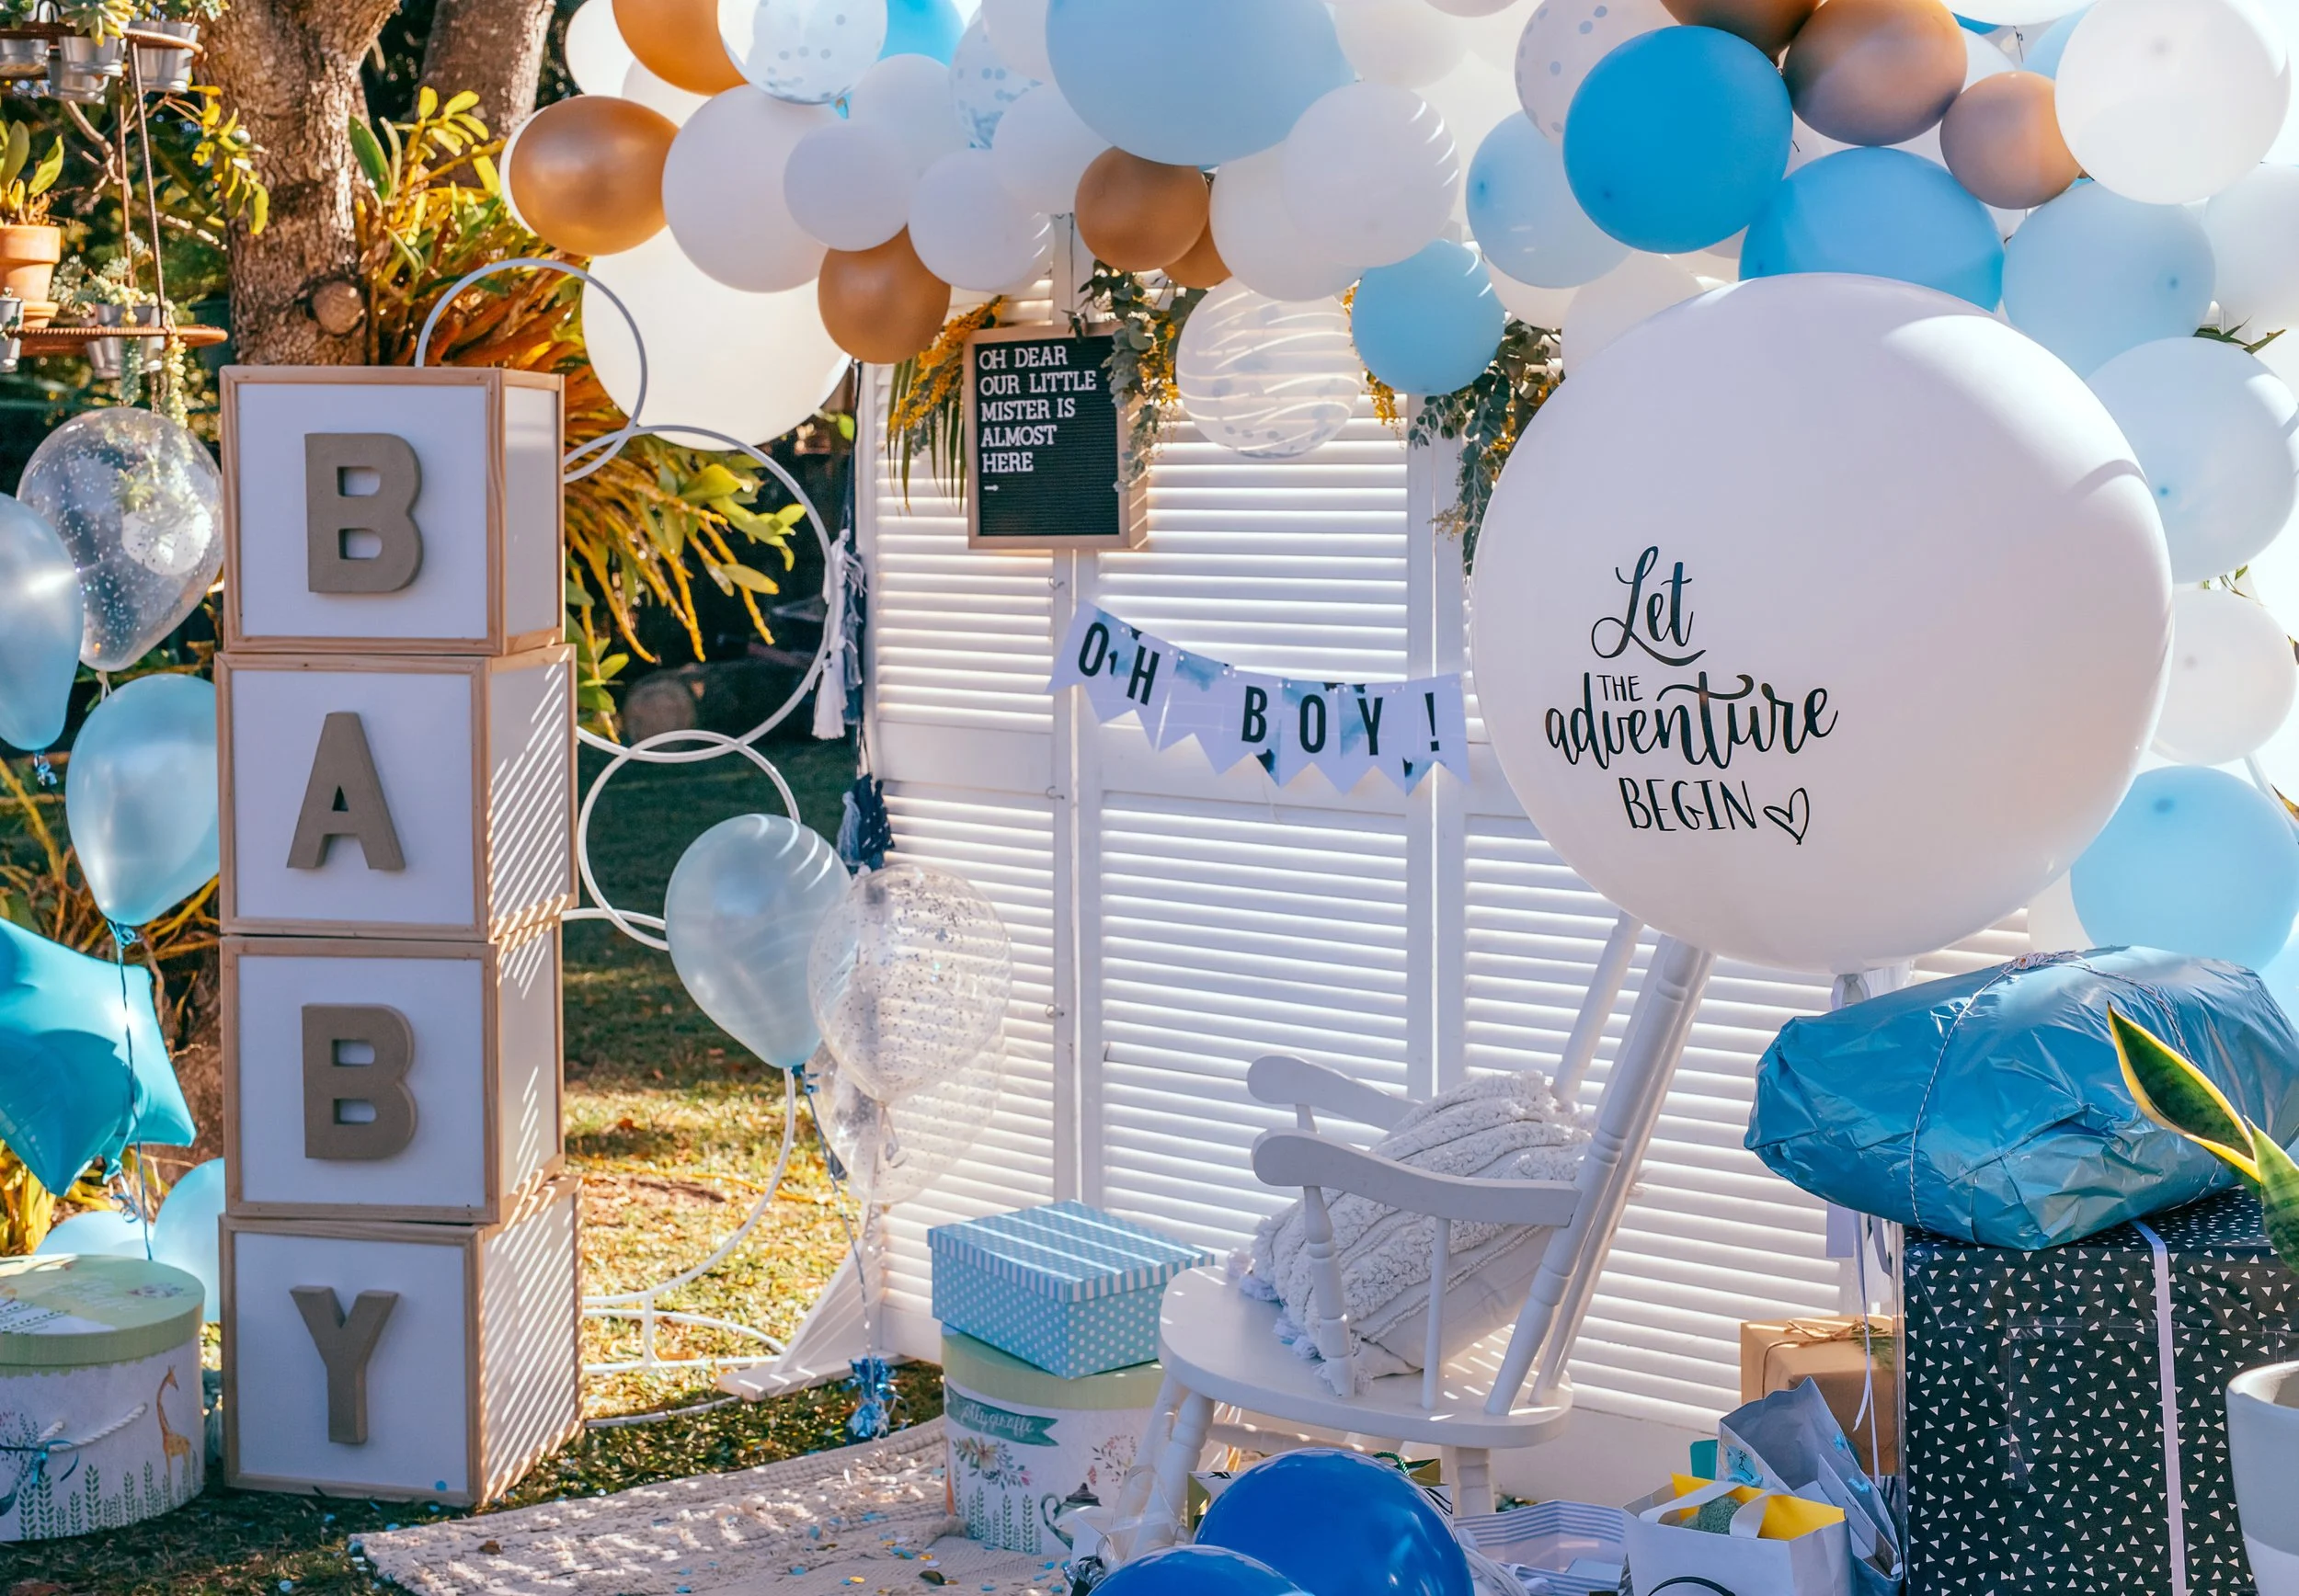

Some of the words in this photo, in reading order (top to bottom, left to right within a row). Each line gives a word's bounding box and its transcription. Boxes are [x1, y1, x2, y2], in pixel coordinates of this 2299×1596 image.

[979, 348, 1007, 370] OH
[1014, 346, 1069, 367] DEAR
[979, 374, 1021, 396] OUR
[1029, 370, 1097, 393] LITTLE
[980, 399, 1050, 422] MISTER
[1057, 397, 1076, 418] IS
[980, 425, 1058, 448] ALMOST
[981, 451, 1034, 473] HERE
[1591, 545, 1707, 667] Let
[1078, 621, 1161, 706] OH
[1596, 675, 1643, 702] THE
[1545, 671, 1838, 770] adventure
[1618, 777, 1757, 832] BEGIN
